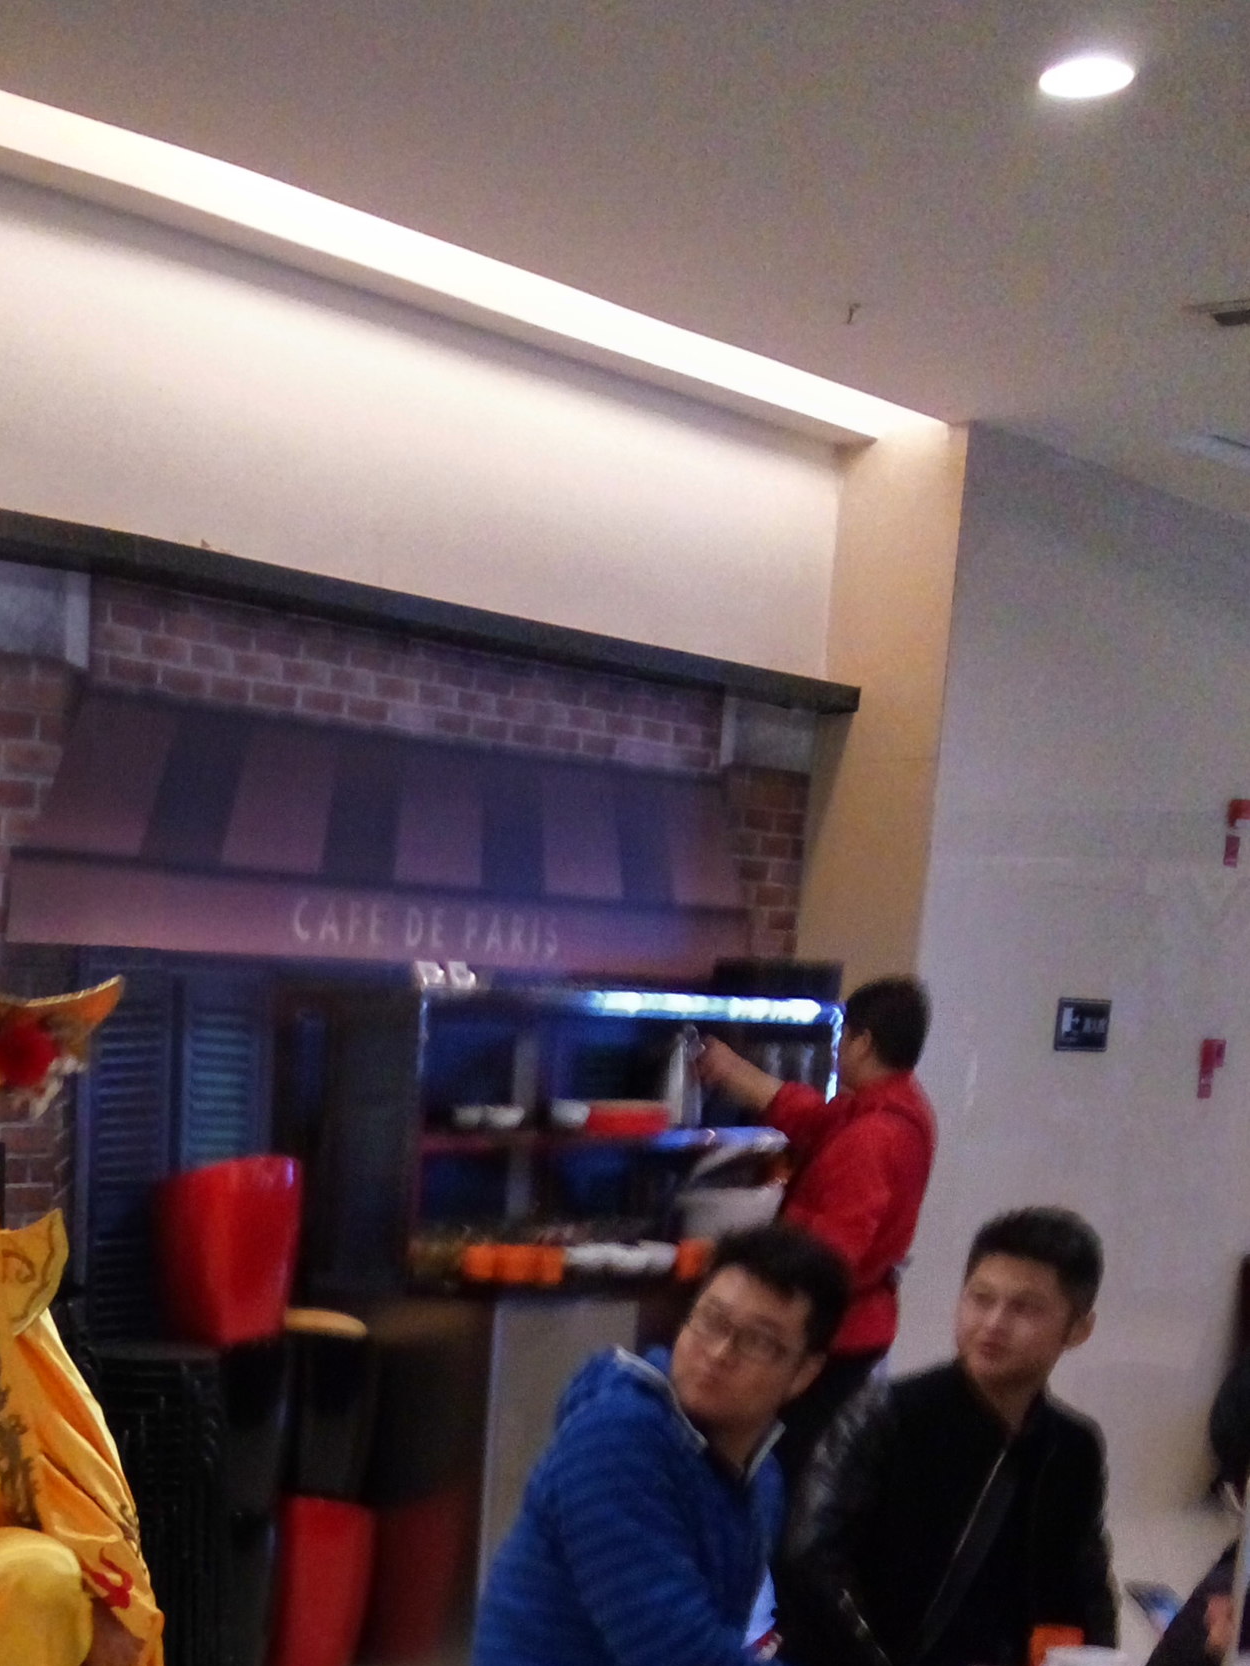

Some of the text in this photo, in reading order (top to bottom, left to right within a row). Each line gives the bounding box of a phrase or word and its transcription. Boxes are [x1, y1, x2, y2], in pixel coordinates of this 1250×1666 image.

[293, 899, 558, 958] CAFE DE PARIS
